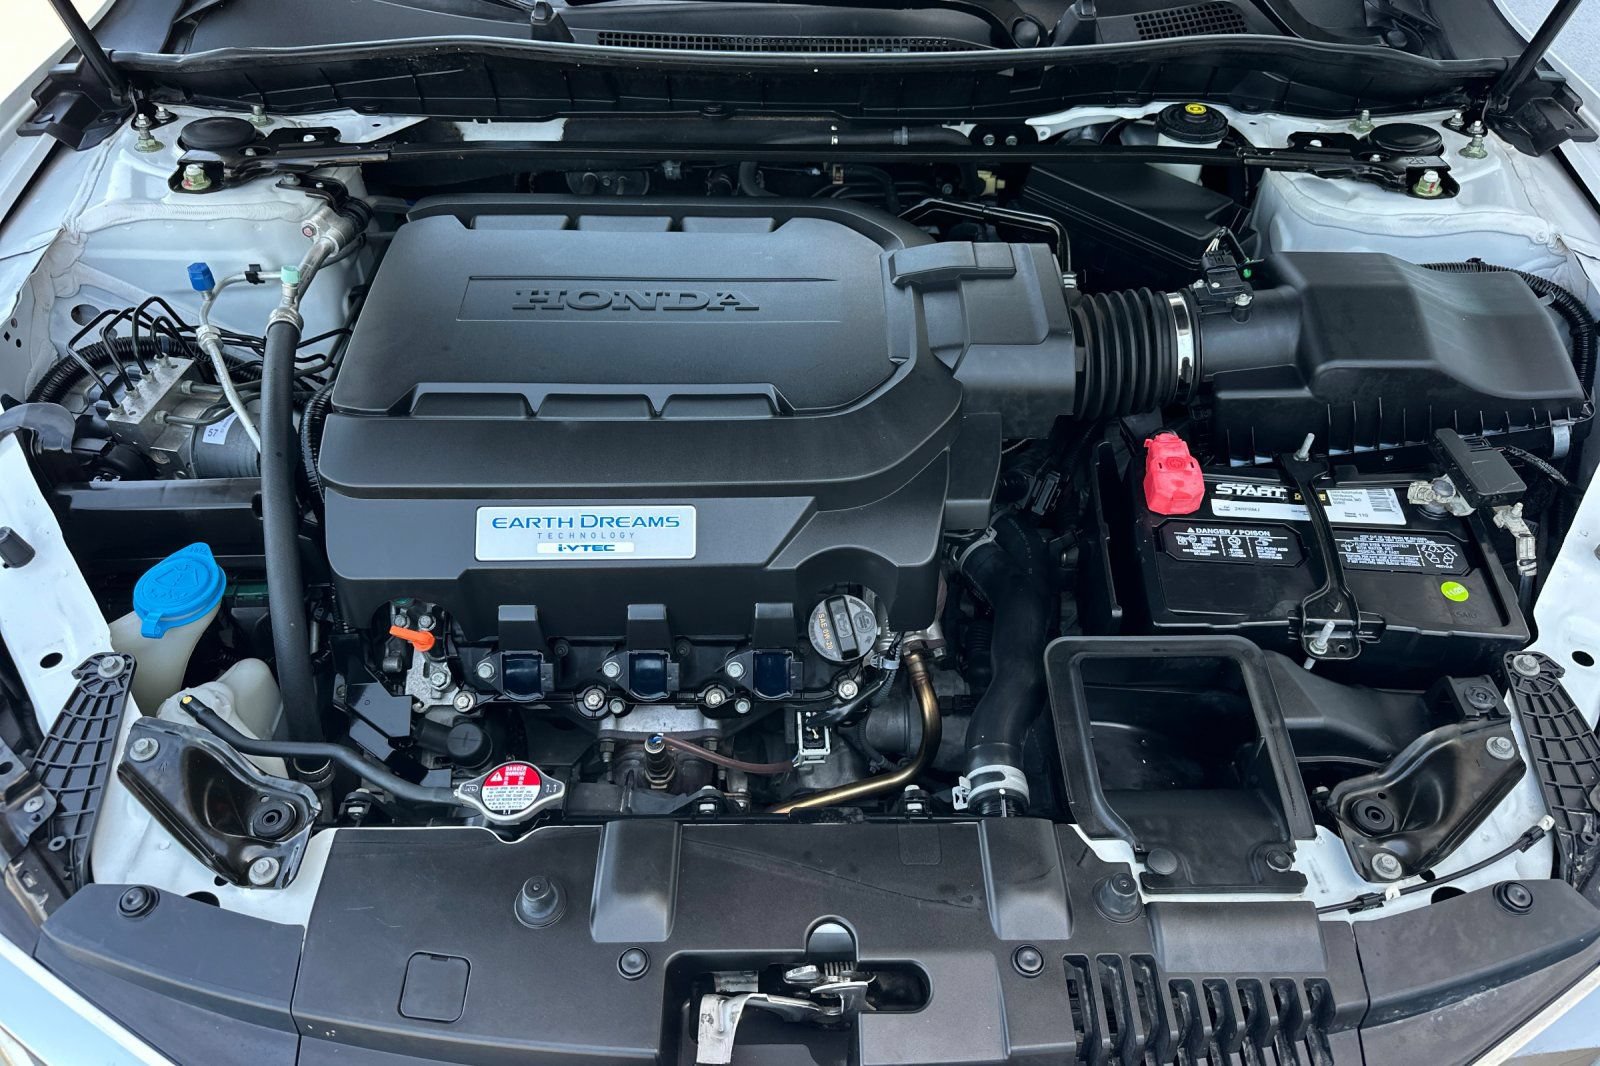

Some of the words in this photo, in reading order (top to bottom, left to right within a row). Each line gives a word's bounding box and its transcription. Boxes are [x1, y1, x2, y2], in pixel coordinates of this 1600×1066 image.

[512, 289, 759, 311] HONDA
[207, 428, 219, 437] 57
[1215, 483, 1287, 497] START
[492, 517, 574, 529] EARTH
[580, 514, 680, 528] DREAMS
[818, 613, 827, 628] SAE
[822, 628, 833, 650] 0W-20
